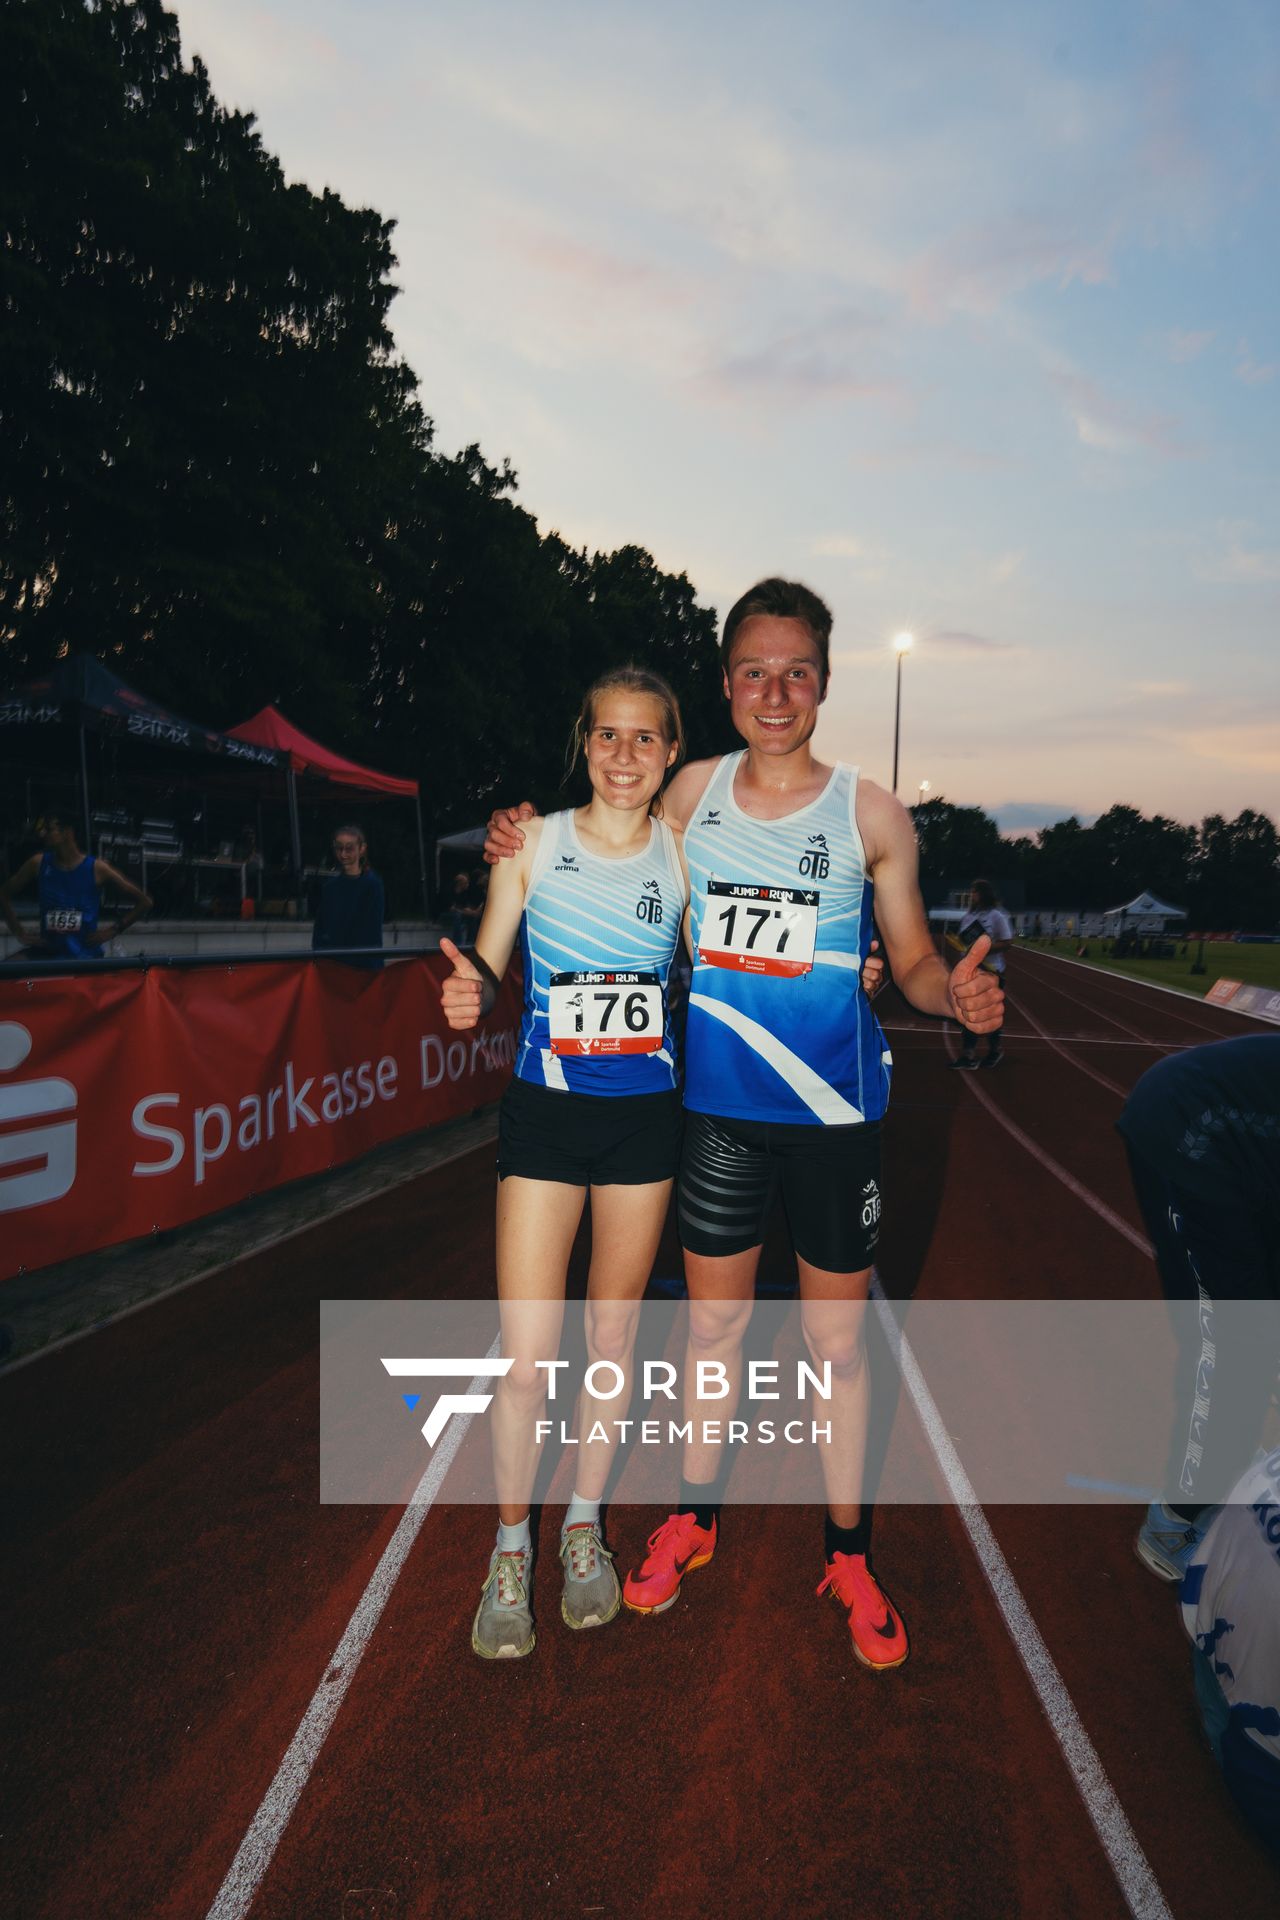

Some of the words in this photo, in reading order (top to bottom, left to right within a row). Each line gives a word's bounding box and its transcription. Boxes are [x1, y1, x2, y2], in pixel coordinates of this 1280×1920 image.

[555, 864, 580, 873] erima
[729, 886, 759, 897] JUMP
[760, 889, 768, 898] N
[769, 890, 794, 901] RUN
[719, 905, 798, 953] 177
[573, 973, 605, 983] JUMP
[606, 974, 615, 983] N
[616, 974, 639, 983] RUN
[566, 992, 650, 1033] 176
[131, 1055, 399, 1185] Sparkasse
